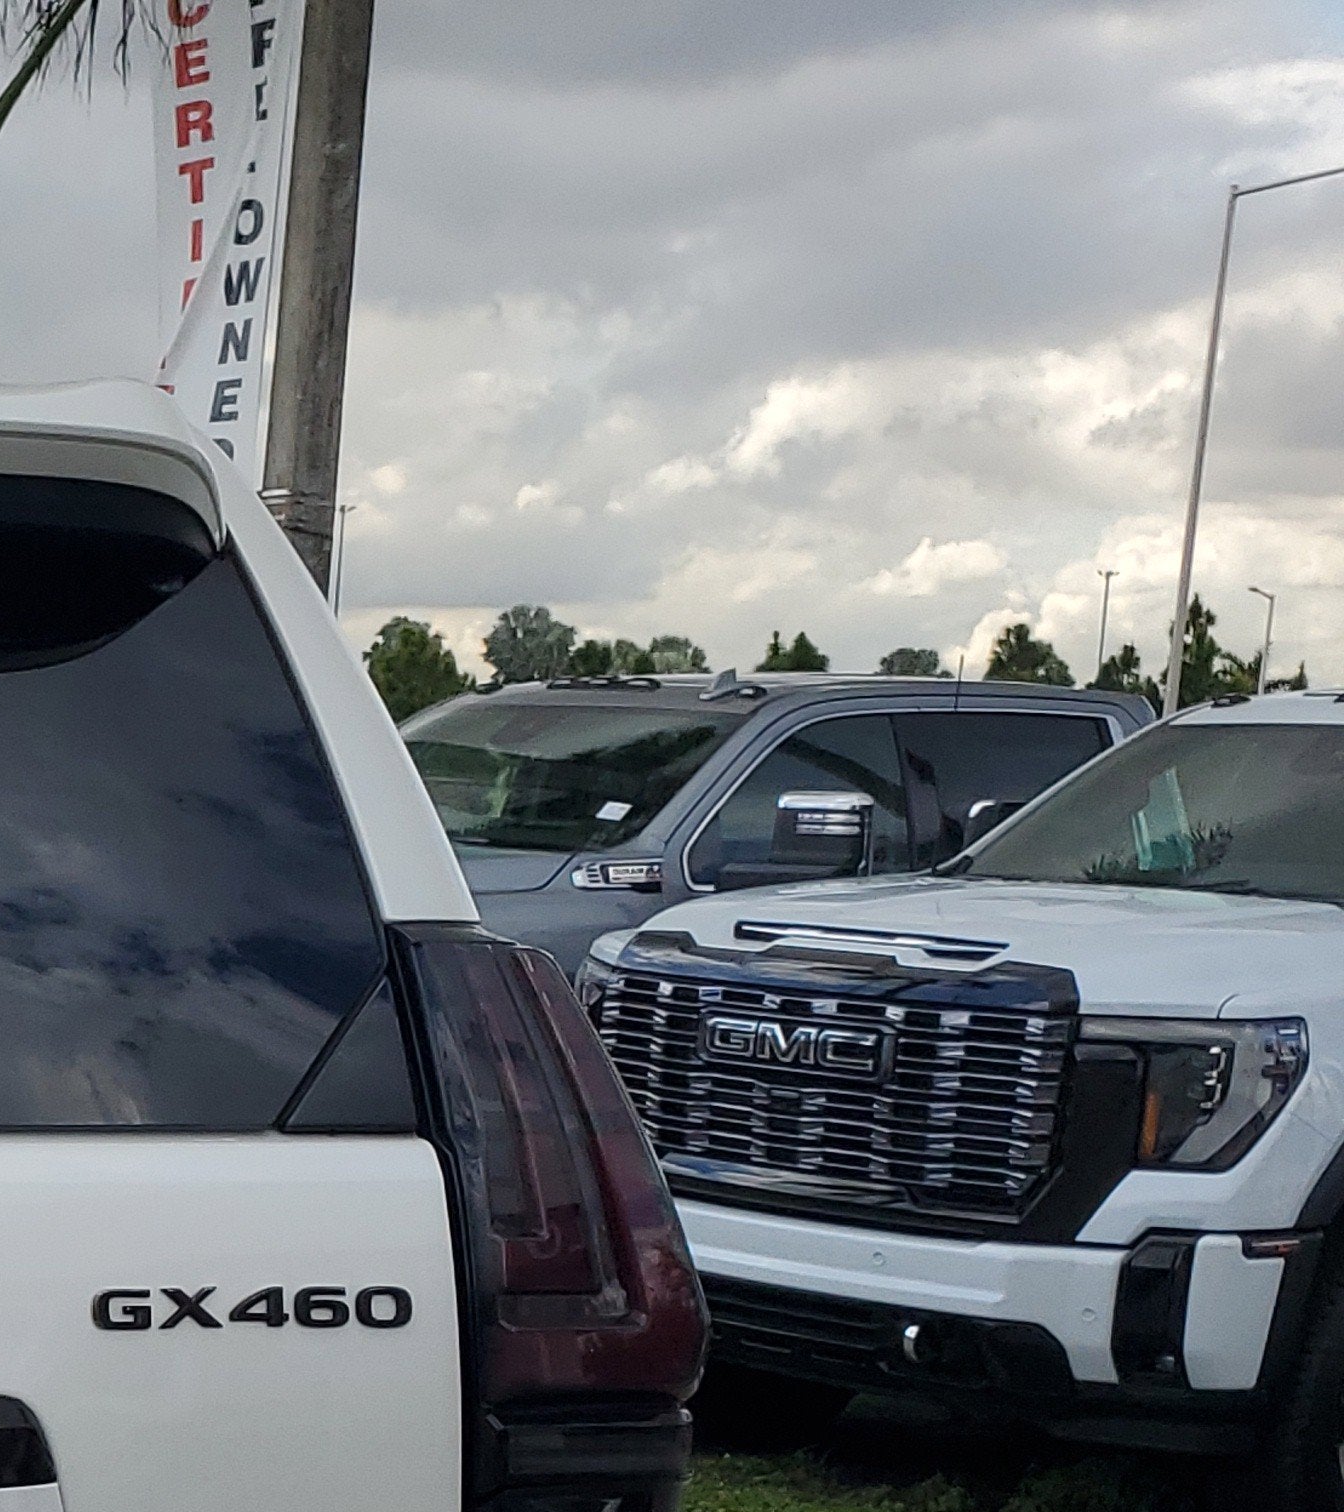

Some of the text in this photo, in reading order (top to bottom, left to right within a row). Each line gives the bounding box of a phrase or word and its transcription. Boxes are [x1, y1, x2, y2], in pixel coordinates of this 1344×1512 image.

[155, 0, 214, 394] CERTI
[707, 1016, 878, 1073] GMC
[90, 1285, 413, 1331] GX460
